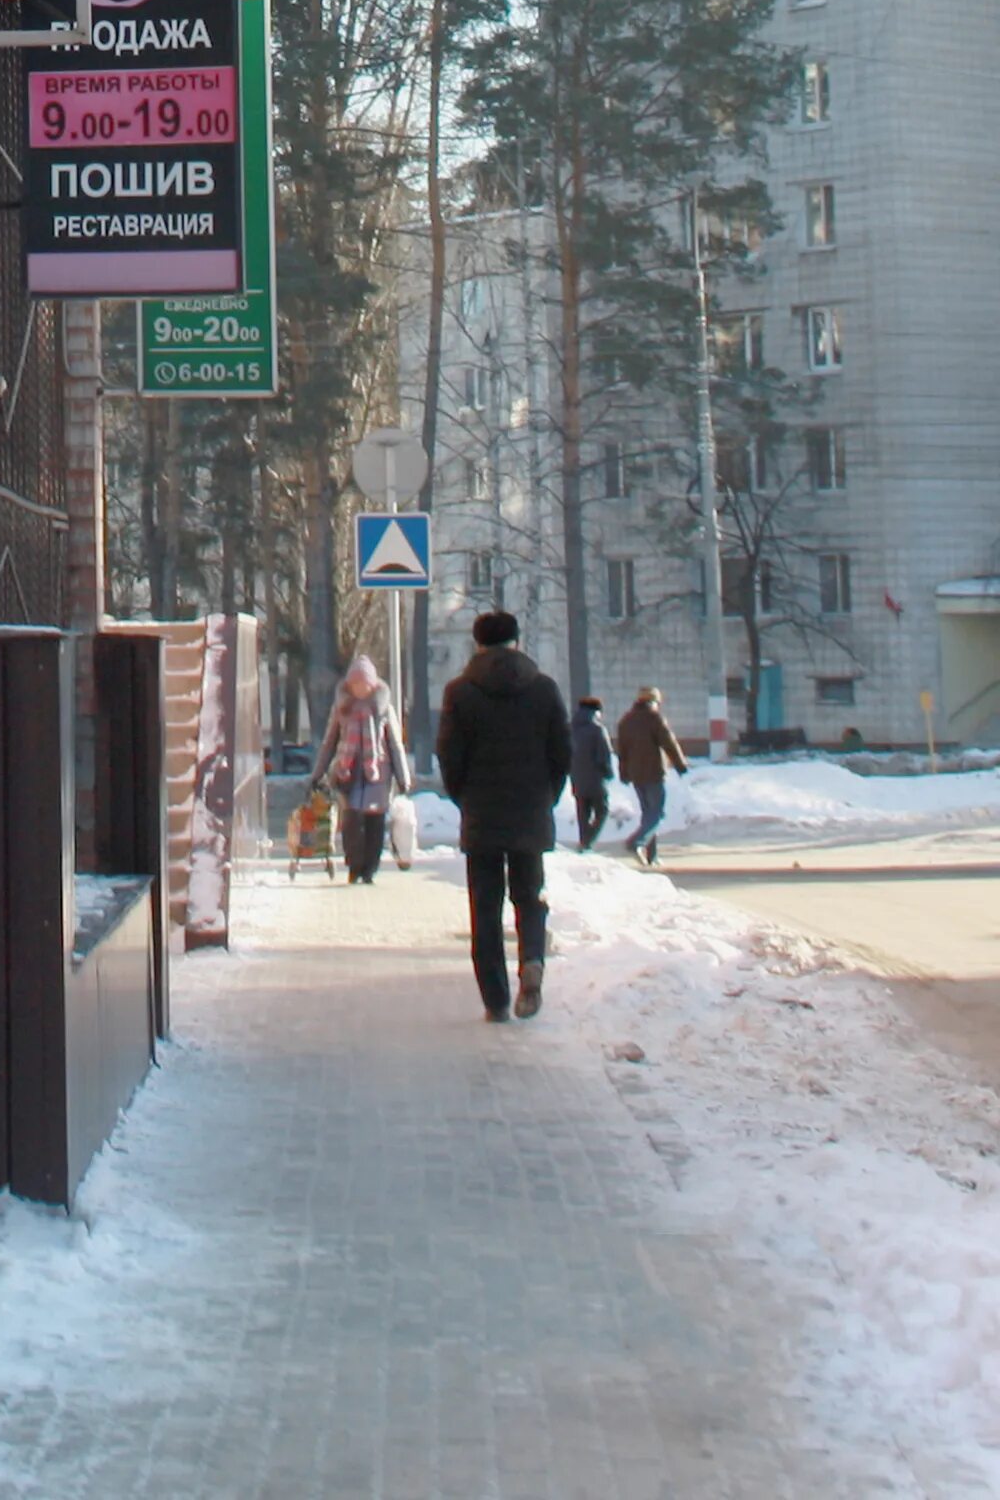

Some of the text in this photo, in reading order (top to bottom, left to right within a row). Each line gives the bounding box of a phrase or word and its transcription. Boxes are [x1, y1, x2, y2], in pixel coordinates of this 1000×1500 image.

[45, 73, 220, 94] ВРЕМЯ РАБОТЫ
[42, 98, 229, 140] 9.00-19.00
[50, 161, 215, 198] ПОШИВ
[53, 212, 214, 240] РЕСТАВРАЦИЯ
[163, 298, 249, 314] ЕЖЕДНЕВНО
[178, 362, 261, 382] 6-00-15
